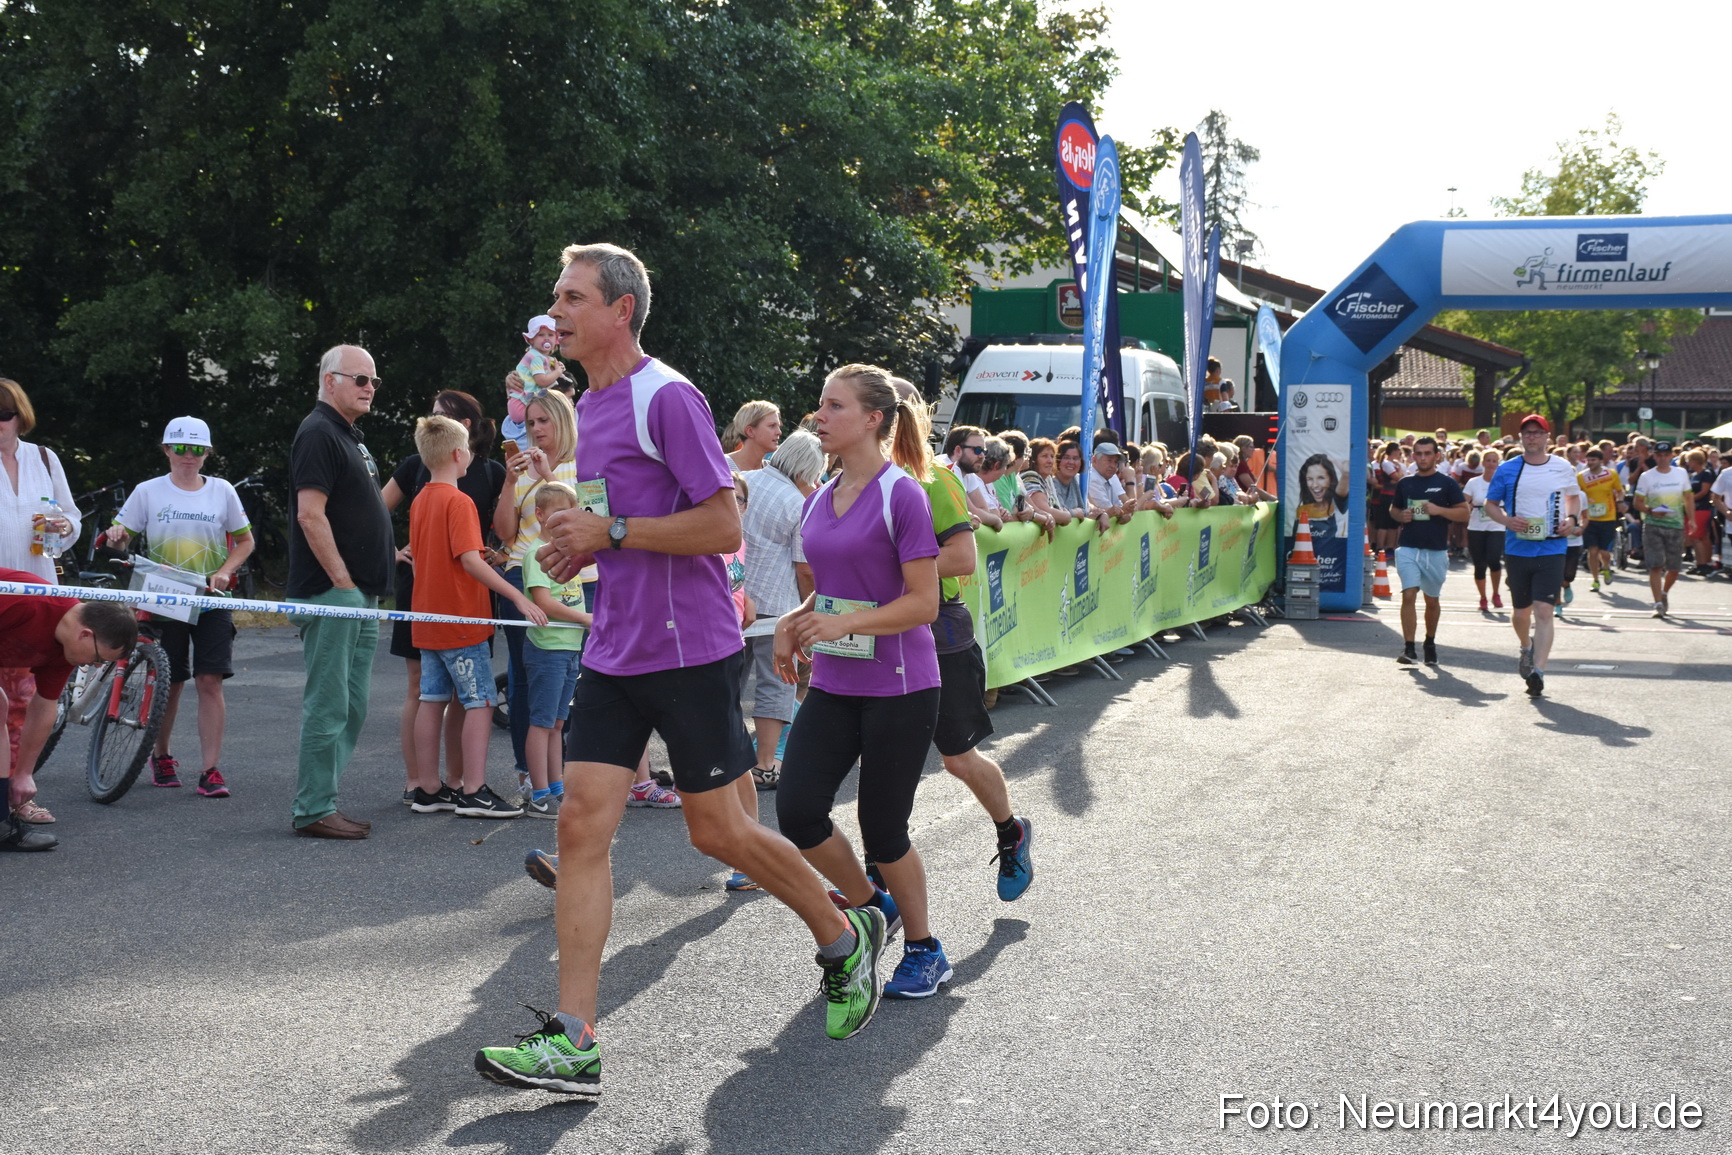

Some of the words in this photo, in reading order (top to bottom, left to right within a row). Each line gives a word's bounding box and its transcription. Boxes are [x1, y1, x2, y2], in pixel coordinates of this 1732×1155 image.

[1587, 244, 1625, 252] Fischer
[1557, 262, 1672, 283] firmenlauf
[1556, 283, 1603, 291] neumarkt
[1346, 301, 1404, 313] Fischer
[976, 370, 1019, 380] abavent
[172, 510, 216, 523] firmenlauf
[51, 587, 150, 604] Raiffeisenbank
[181, 597, 271, 612] Raiffeisenbank
